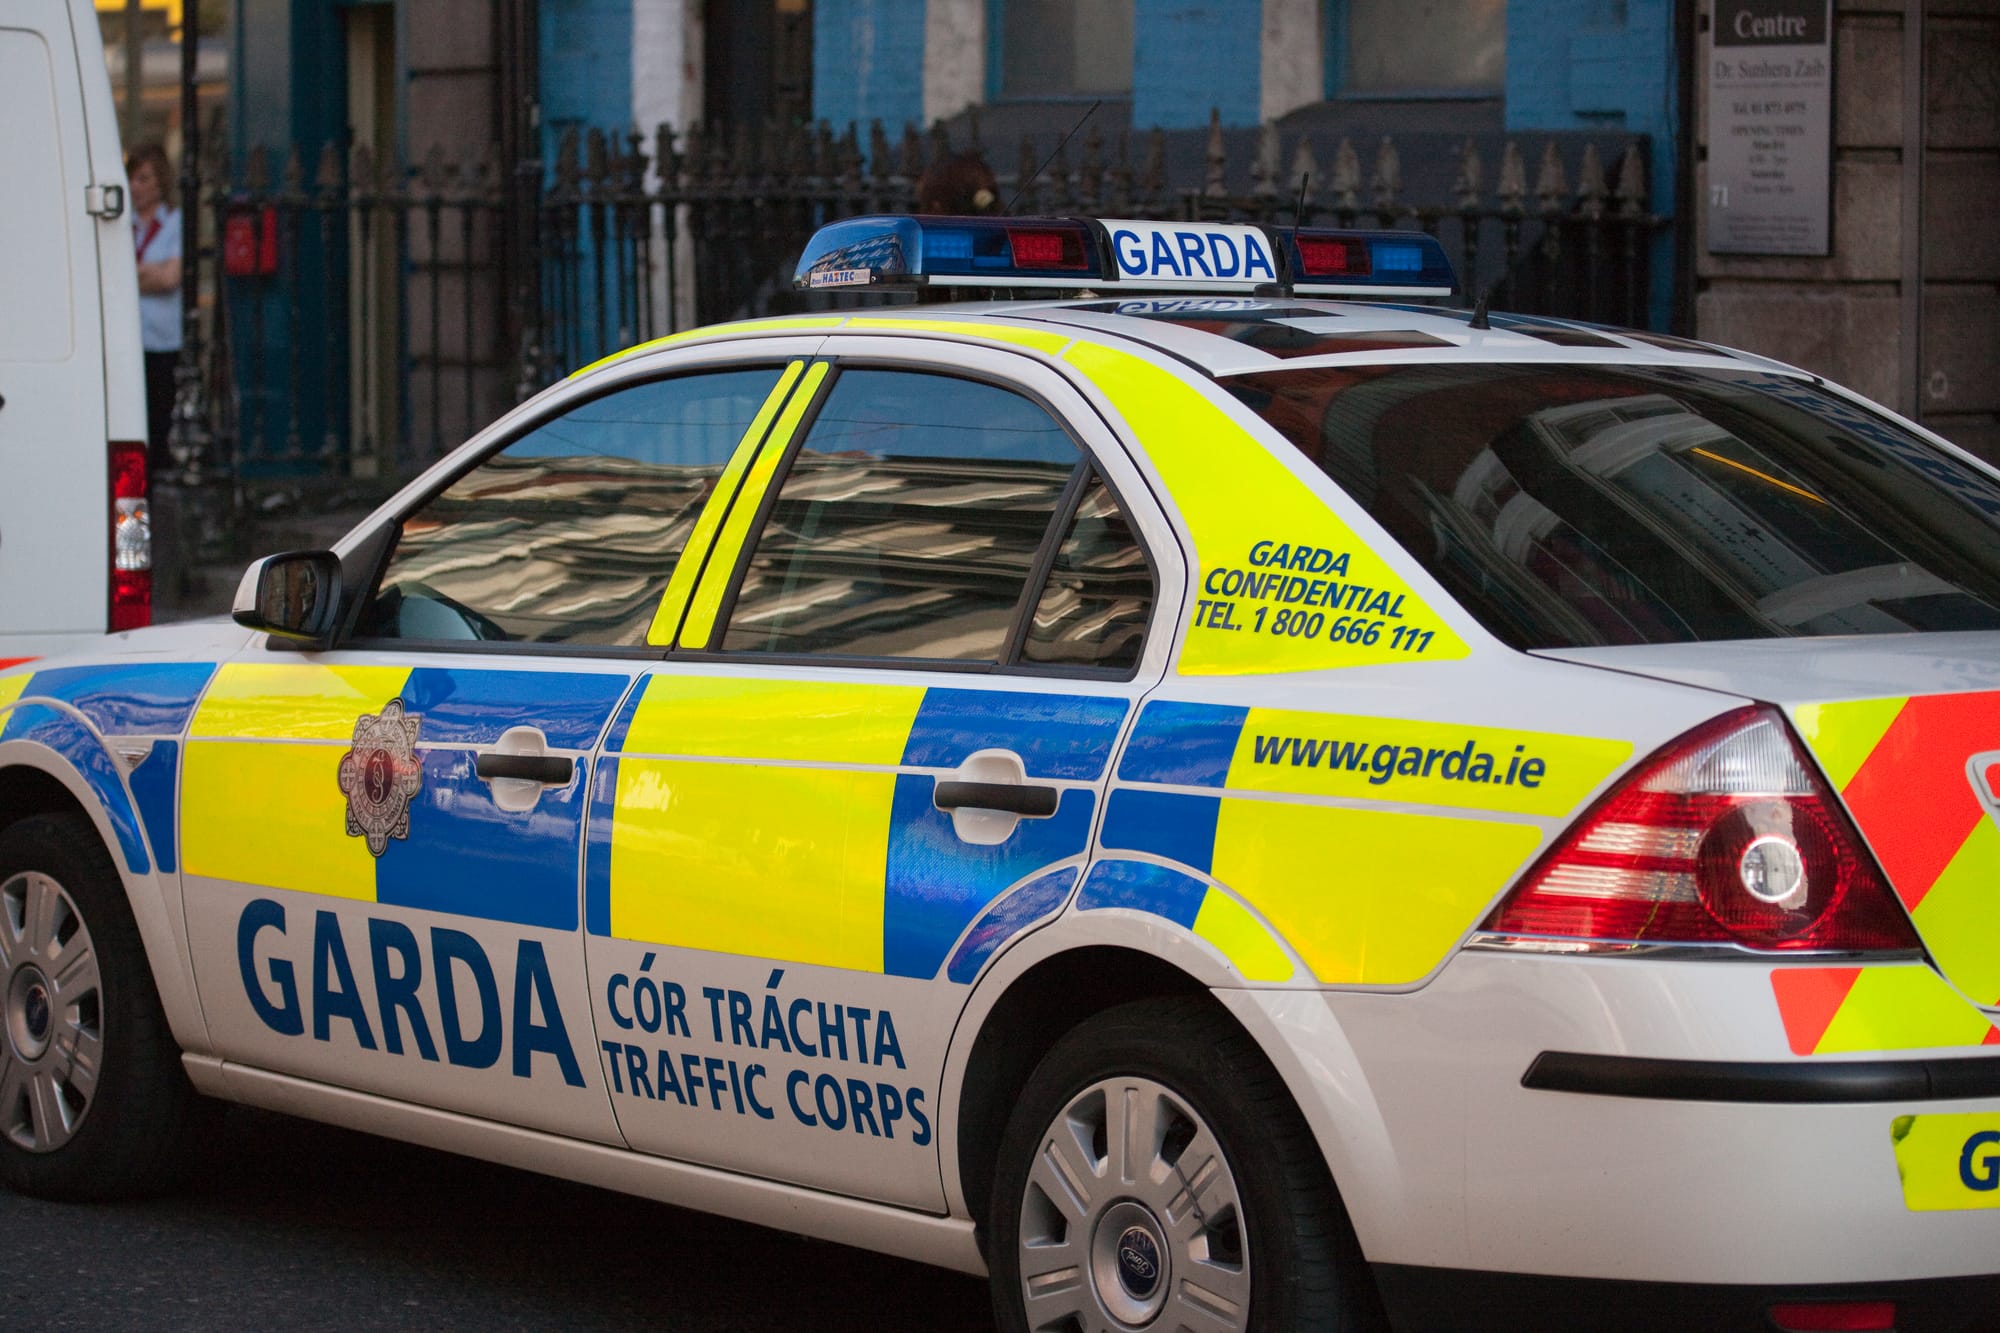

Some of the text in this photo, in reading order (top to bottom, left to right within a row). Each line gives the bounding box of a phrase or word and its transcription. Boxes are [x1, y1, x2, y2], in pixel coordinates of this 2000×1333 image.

[1734, 10, 1807, 38] Centre
[823, 271, 855, 283] HAZTEC
[1113, 230, 1275, 279] GARDA
[1249, 541, 1351, 577] GARDA
[1205, 568, 1405, 618] CONFIDENTIAL
[1195, 600, 1435, 653] TEL. 1 800 666 111
[1254, 735, 1546, 789] www.garda.ie
[236, 898, 587, 1089] GARDA
[607, 952, 907, 1070] CÓR TRÁCHTA
[601, 1040, 932, 1147] TRAFFIC CORPS
[1959, 1130, 2000, 1192] G
